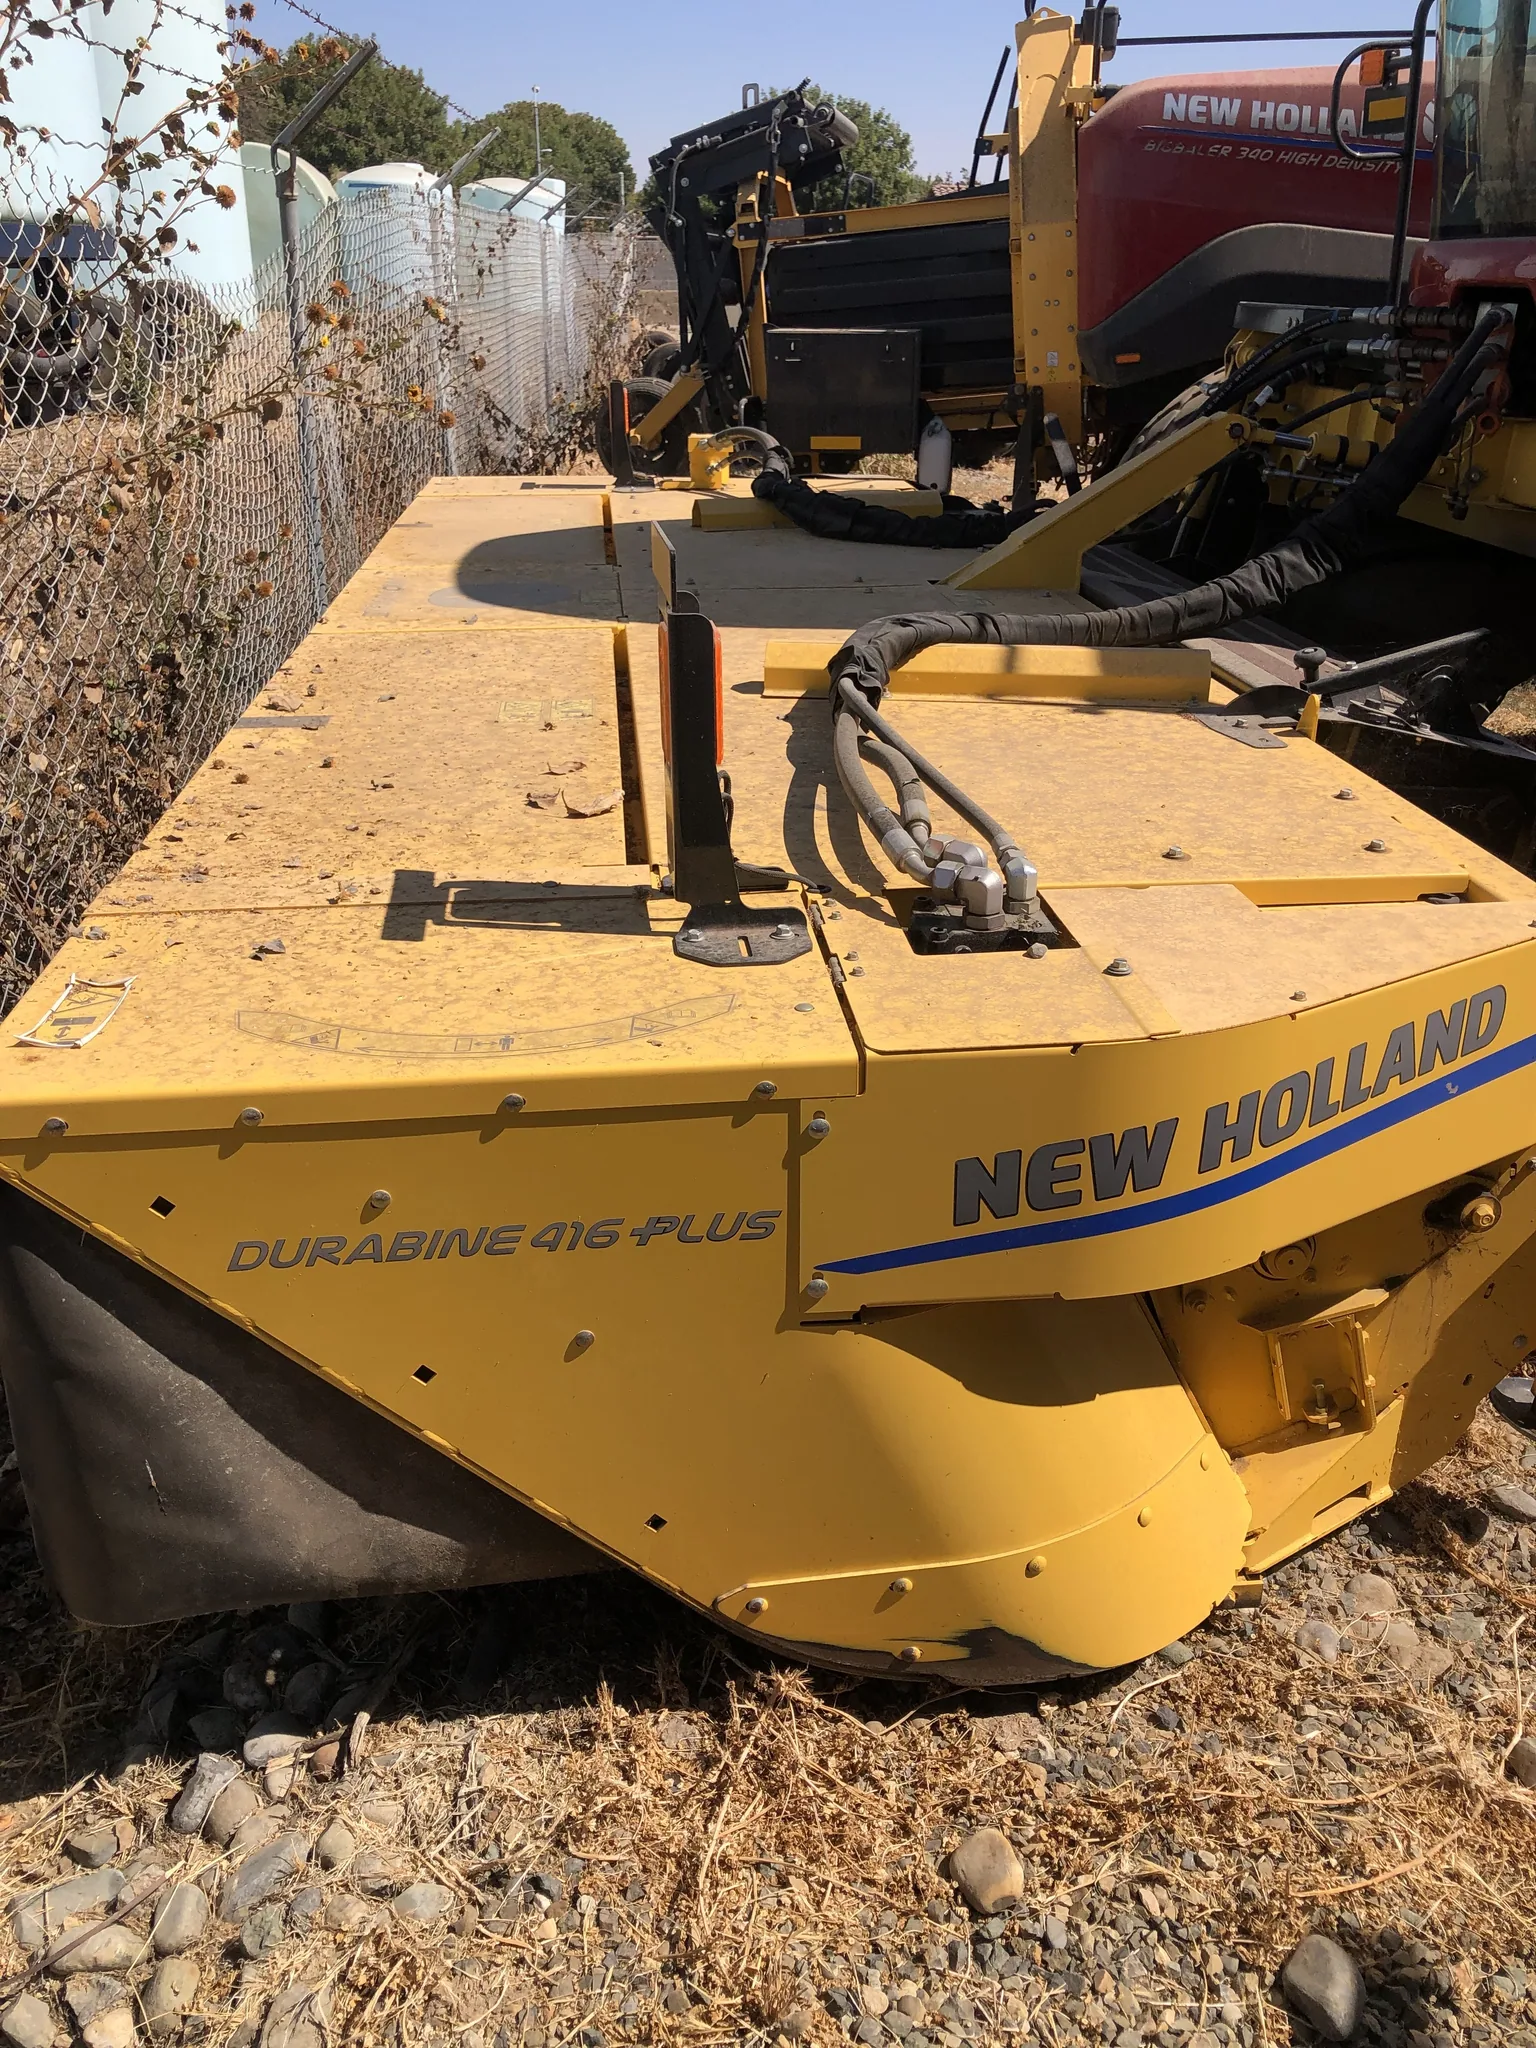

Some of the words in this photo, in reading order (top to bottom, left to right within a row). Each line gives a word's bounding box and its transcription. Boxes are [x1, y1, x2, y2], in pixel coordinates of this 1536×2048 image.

[1162, 92, 1241, 127] NEW
[1250, 100, 1405, 142] HOLLA
[1143, 138, 1233, 158] BIGBALER
[1235, 145, 1274, 162] 340
[1275, 150, 1323, 169] HIGH
[1322, 154, 1403, 174] DENSITY
[952, 1116, 1180, 1226] NEW
[1197, 984, 1507, 1175] HOLLAND
[226, 1224, 526, 1272] DURABINE
[530, 1217, 625, 1252] 416
